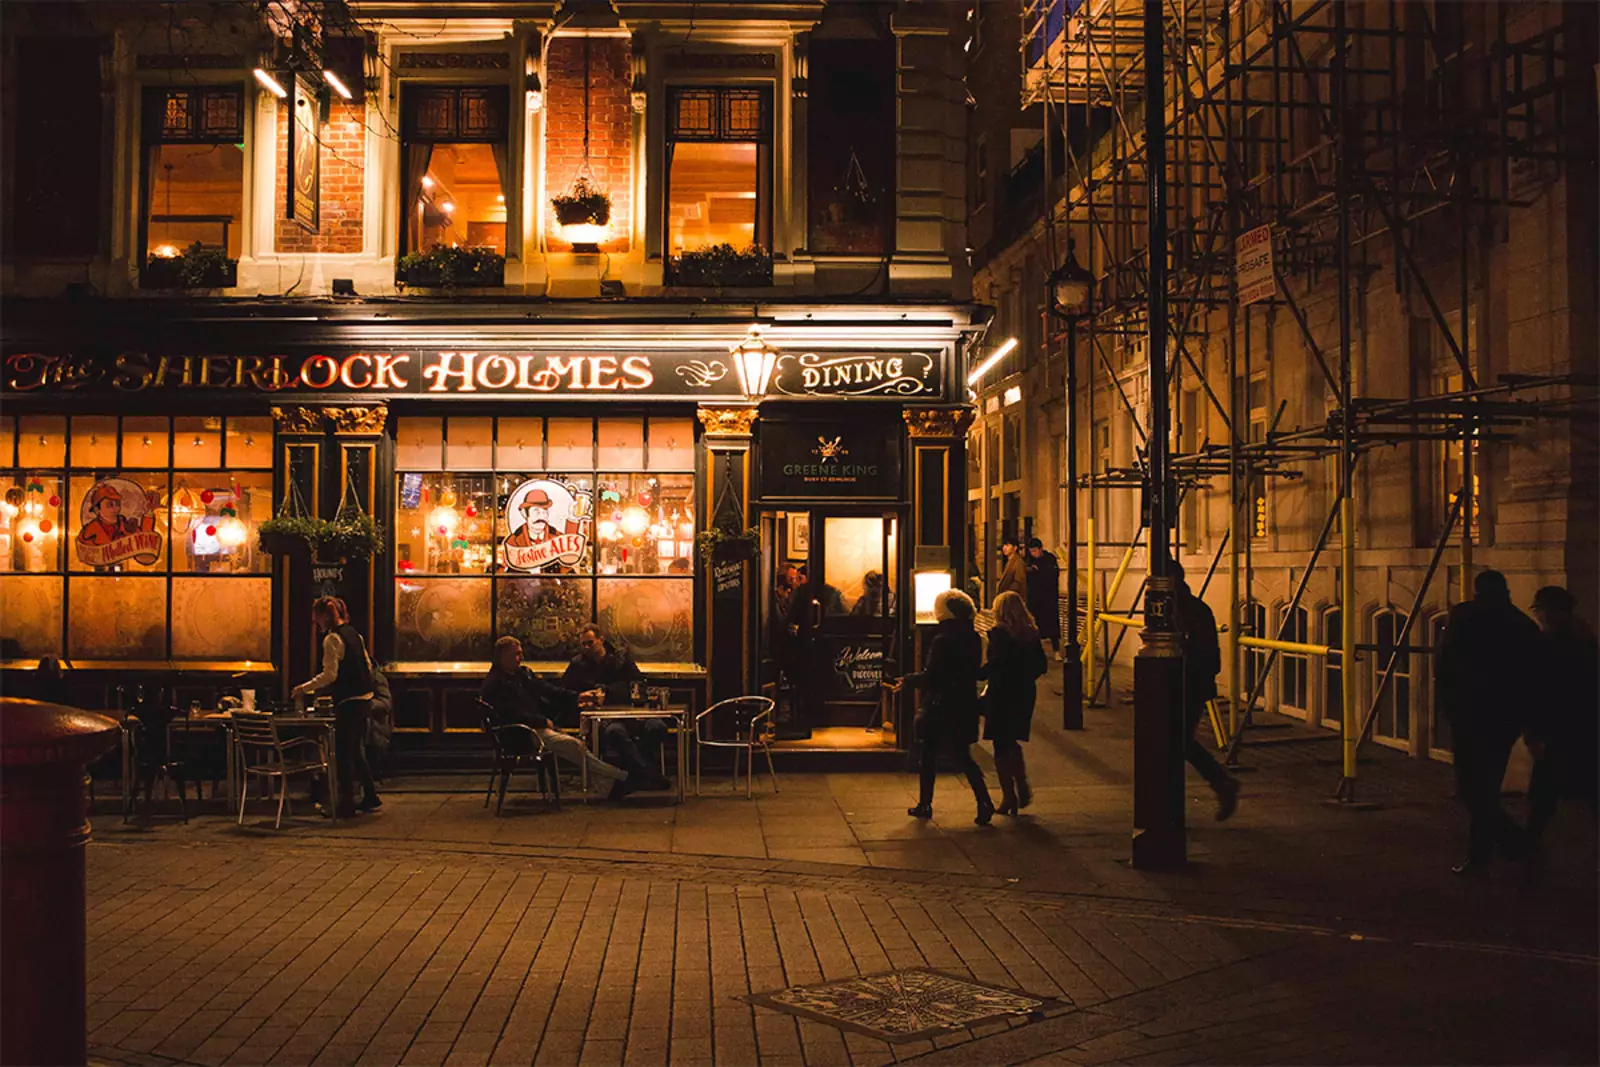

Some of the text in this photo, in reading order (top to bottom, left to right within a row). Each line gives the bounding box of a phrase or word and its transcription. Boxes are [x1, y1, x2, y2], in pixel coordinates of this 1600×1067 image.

[6, 351, 655, 393] The SHERLOCK HOLMES
[802, 357, 904, 389] DINING
[783, 464, 879, 476] GREENE KING
[549, 535, 581, 556] ALES
